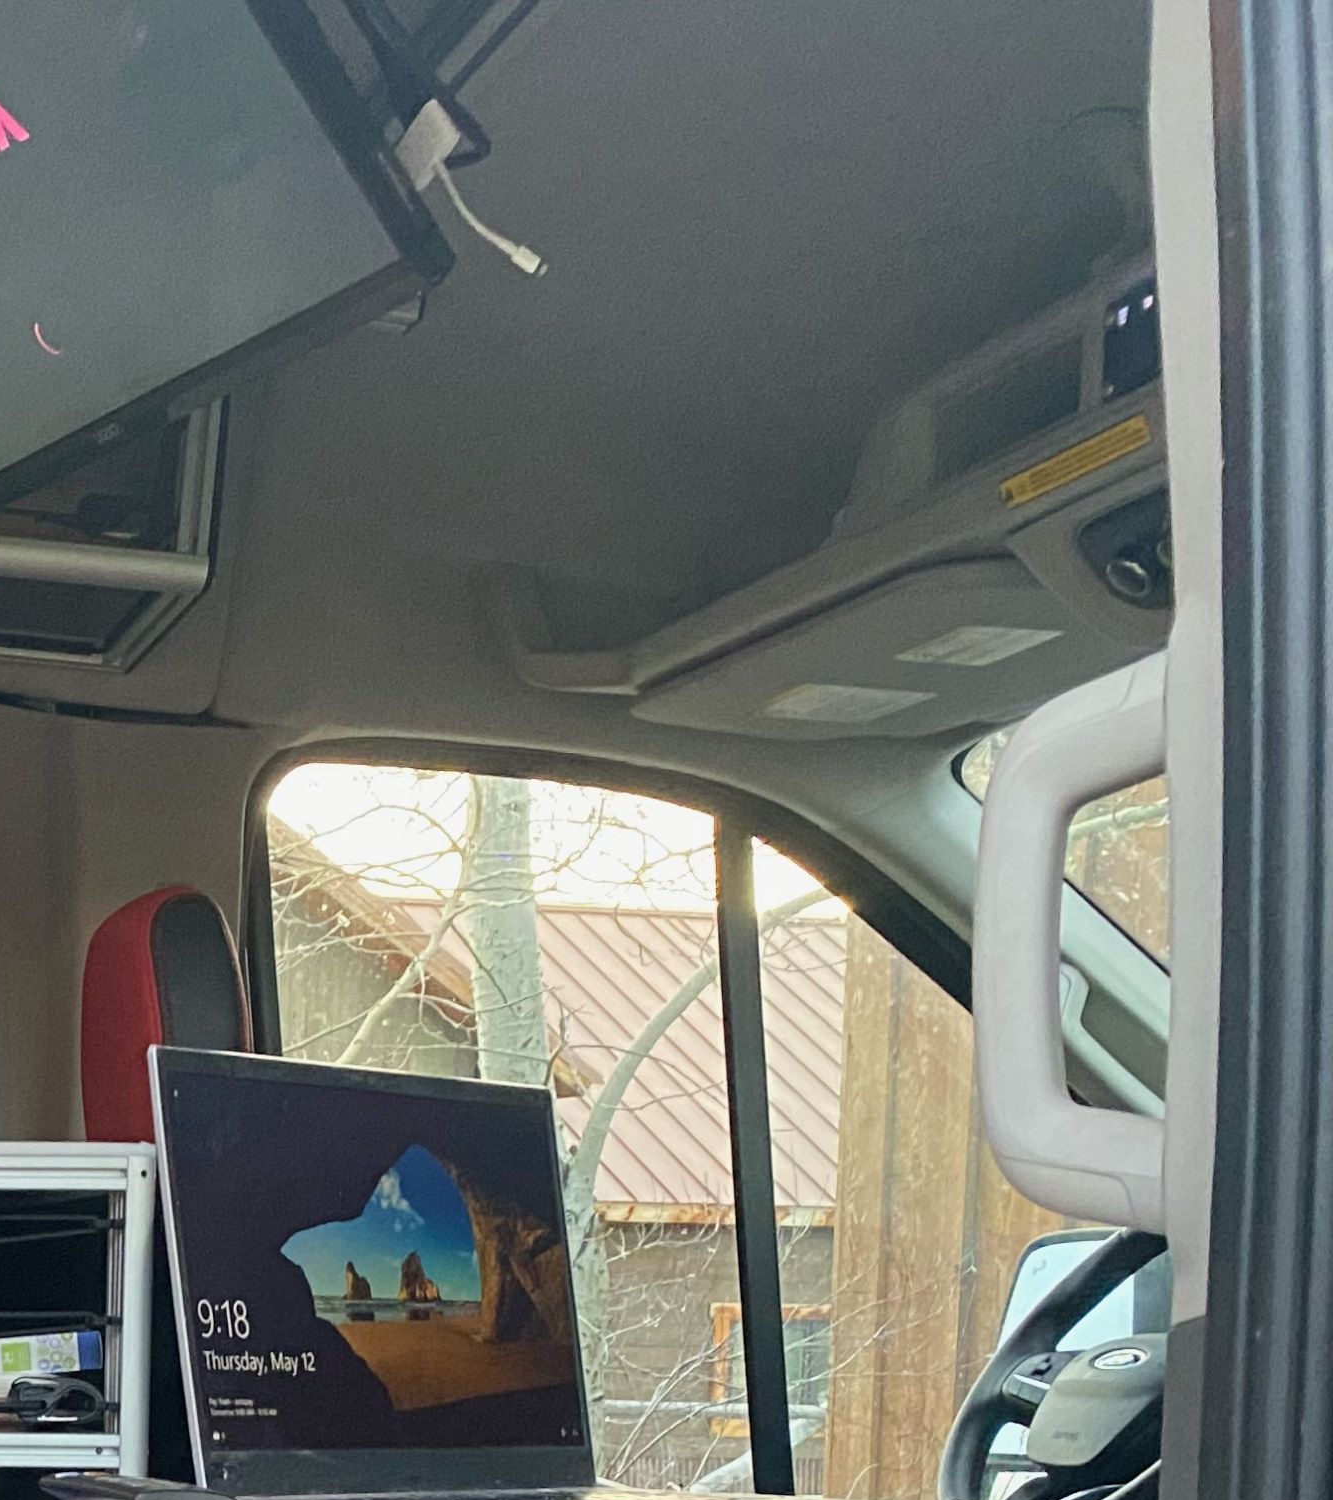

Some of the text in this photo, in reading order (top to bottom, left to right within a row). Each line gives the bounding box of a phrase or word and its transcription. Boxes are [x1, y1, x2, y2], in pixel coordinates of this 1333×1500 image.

[197, 1299, 250, 1339] 9:18
[202, 1350, 316, 1377] Thursday, May 12
